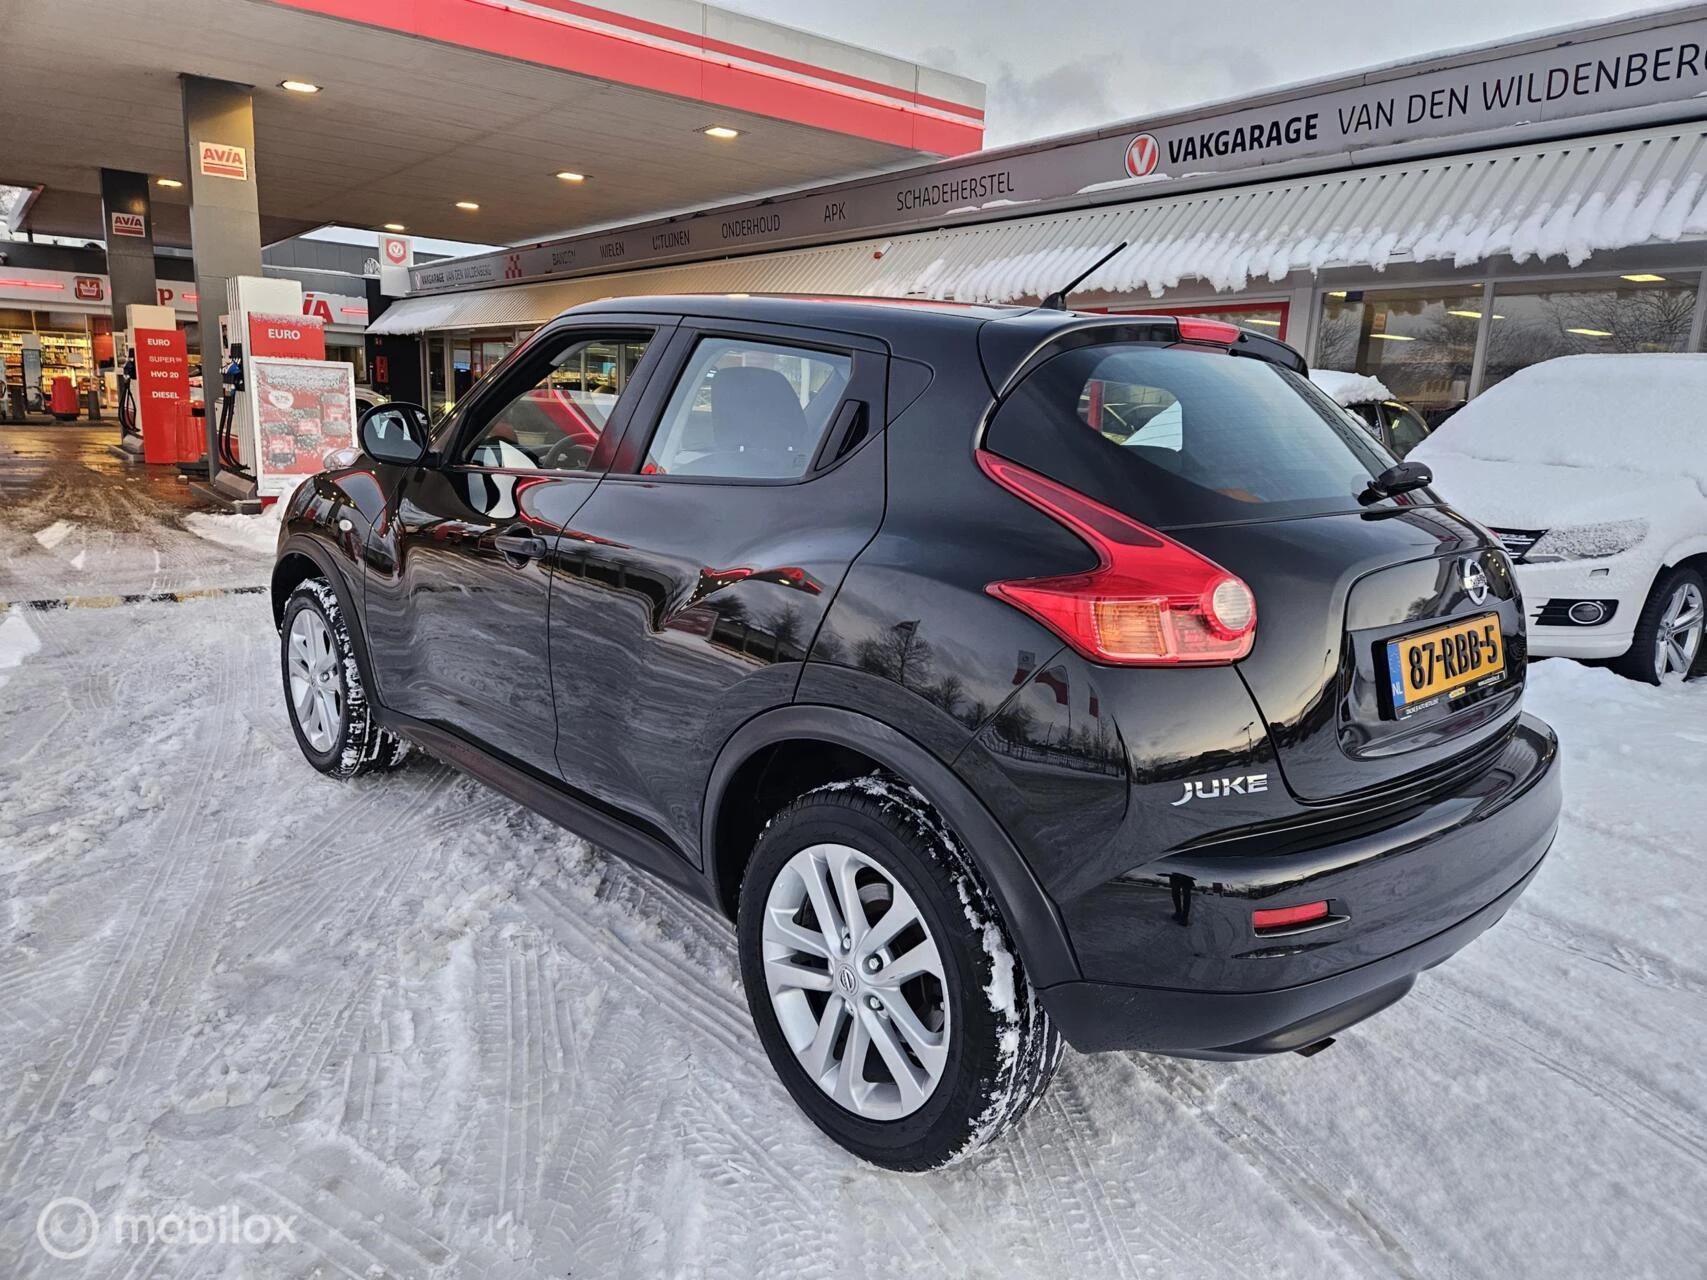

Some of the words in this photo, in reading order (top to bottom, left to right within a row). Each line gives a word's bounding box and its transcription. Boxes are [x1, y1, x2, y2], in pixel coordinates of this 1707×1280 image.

[1168, 113, 1319, 164] VAKGARAGE
[1338, 98, 1395, 135] VAN
[1407, 84, 1469, 124] DEN
[1482, 43, 1707, 111] WILDENBER
[896, 171, 1014, 211] SCHADEHERSTEL
[824, 200, 846, 223] APK
[721, 214, 781, 239] ONDERHOUD
[600, 242, 625, 258] WIELEN
[147, 338, 170, 346] EURO
[268, 328, 301, 340] EURO
[149, 355, 175, 363] SUPER
[150, 370, 168, 378] HVO
[169, 371, 179, 379] 20
[152, 391, 180, 399] DIESEL
[1409, 624, 1498, 690] 87-RBB-5
[1392, 682, 1403, 697] NL
[1171, 773, 1268, 806] JUKE
